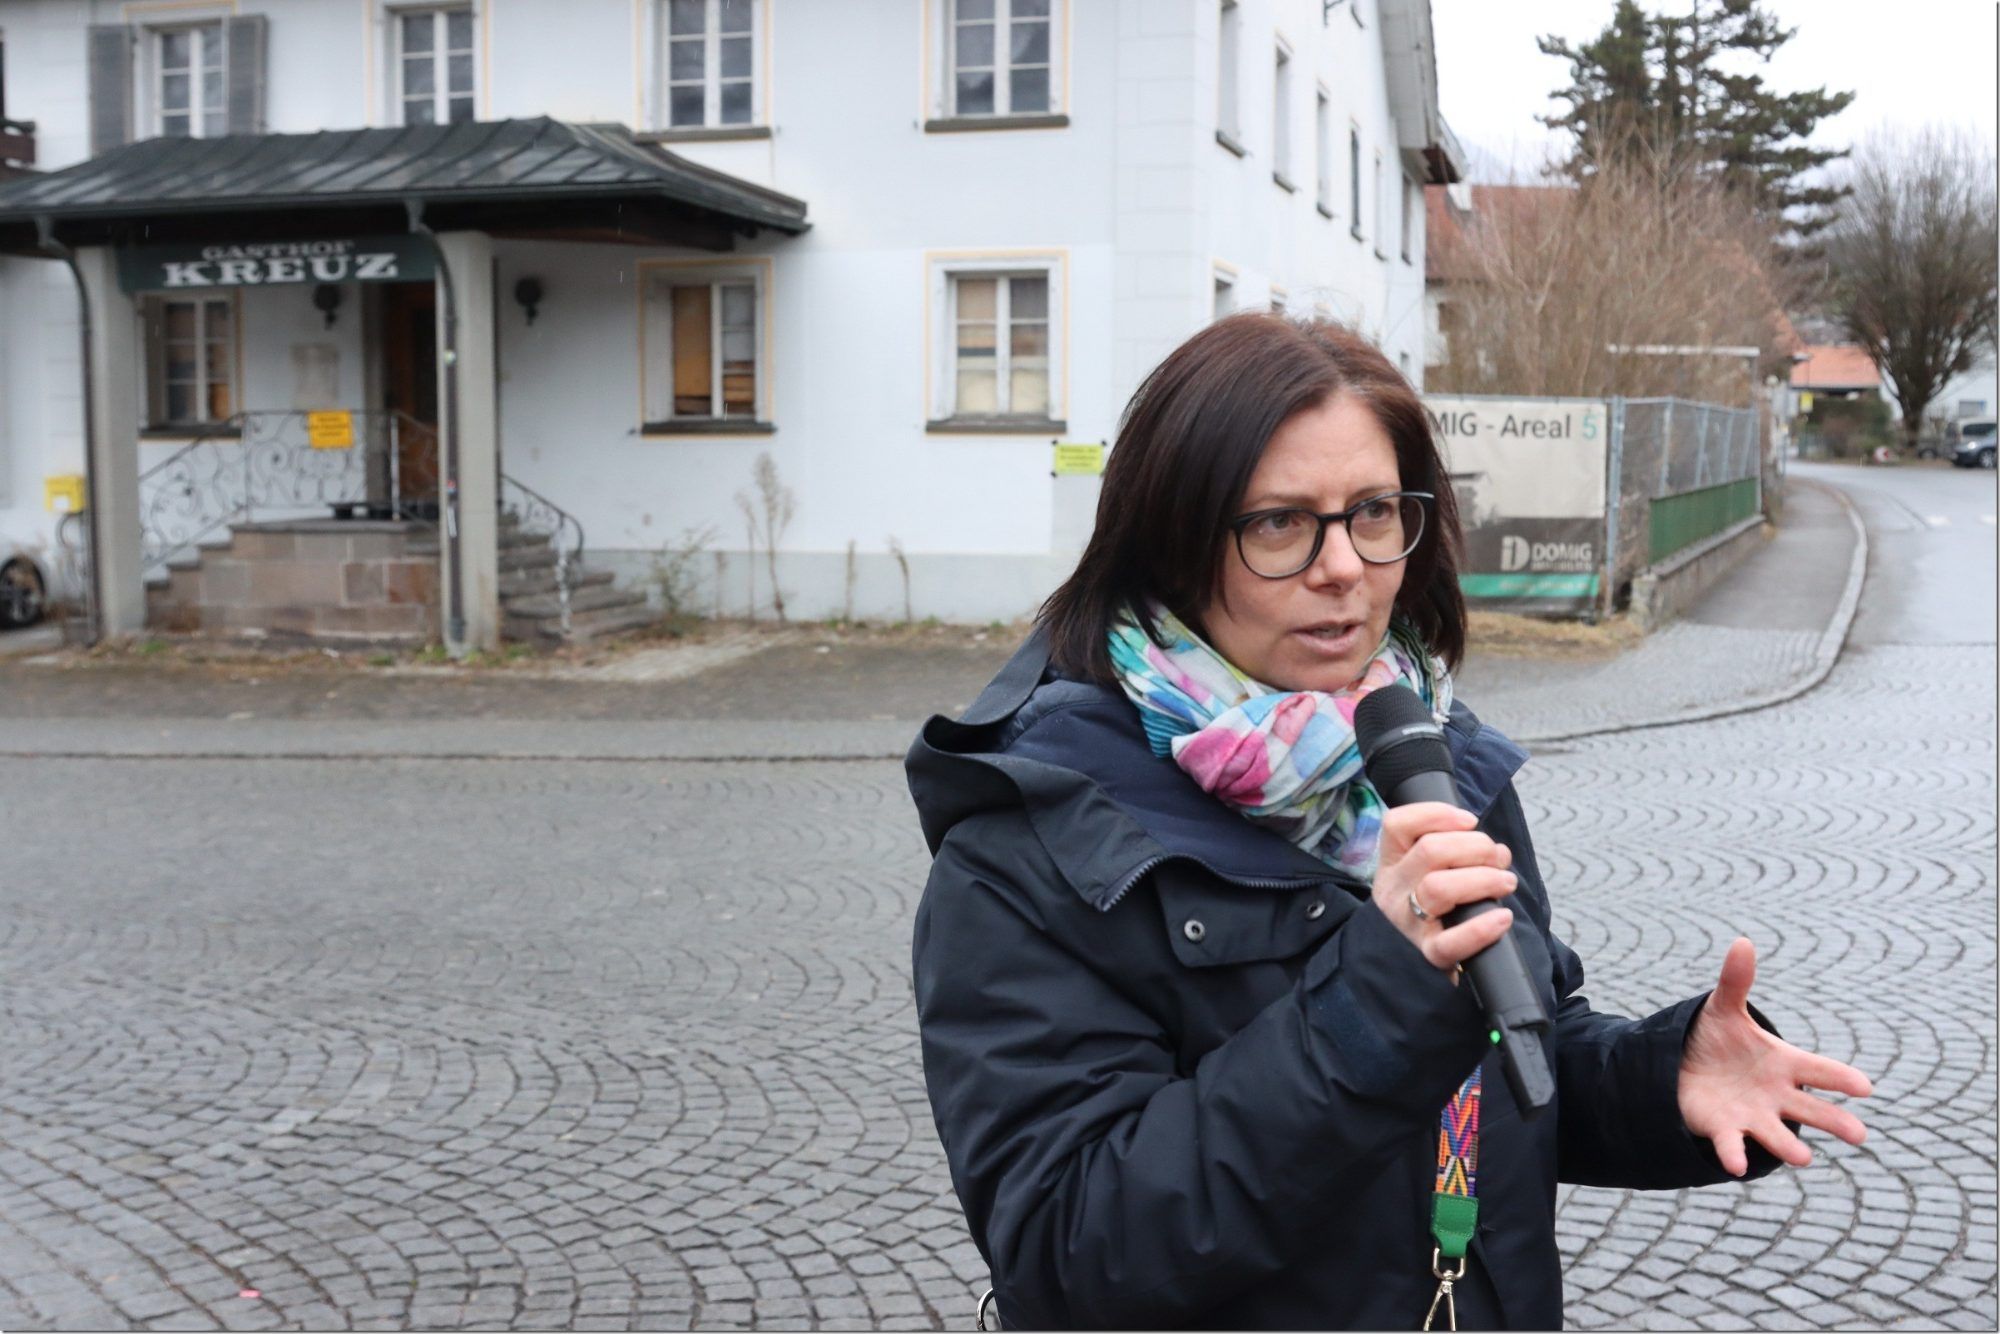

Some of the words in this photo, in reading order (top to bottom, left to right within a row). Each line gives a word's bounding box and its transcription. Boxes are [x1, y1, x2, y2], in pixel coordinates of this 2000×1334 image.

[201, 240, 354, 261] GASTHOF
[162, 252, 398, 287] KREUZ
[1500, 413, 1570, 438] Areal
[1582, 415, 1597, 440] 5
[1532, 542, 1592, 562] DOMIG
